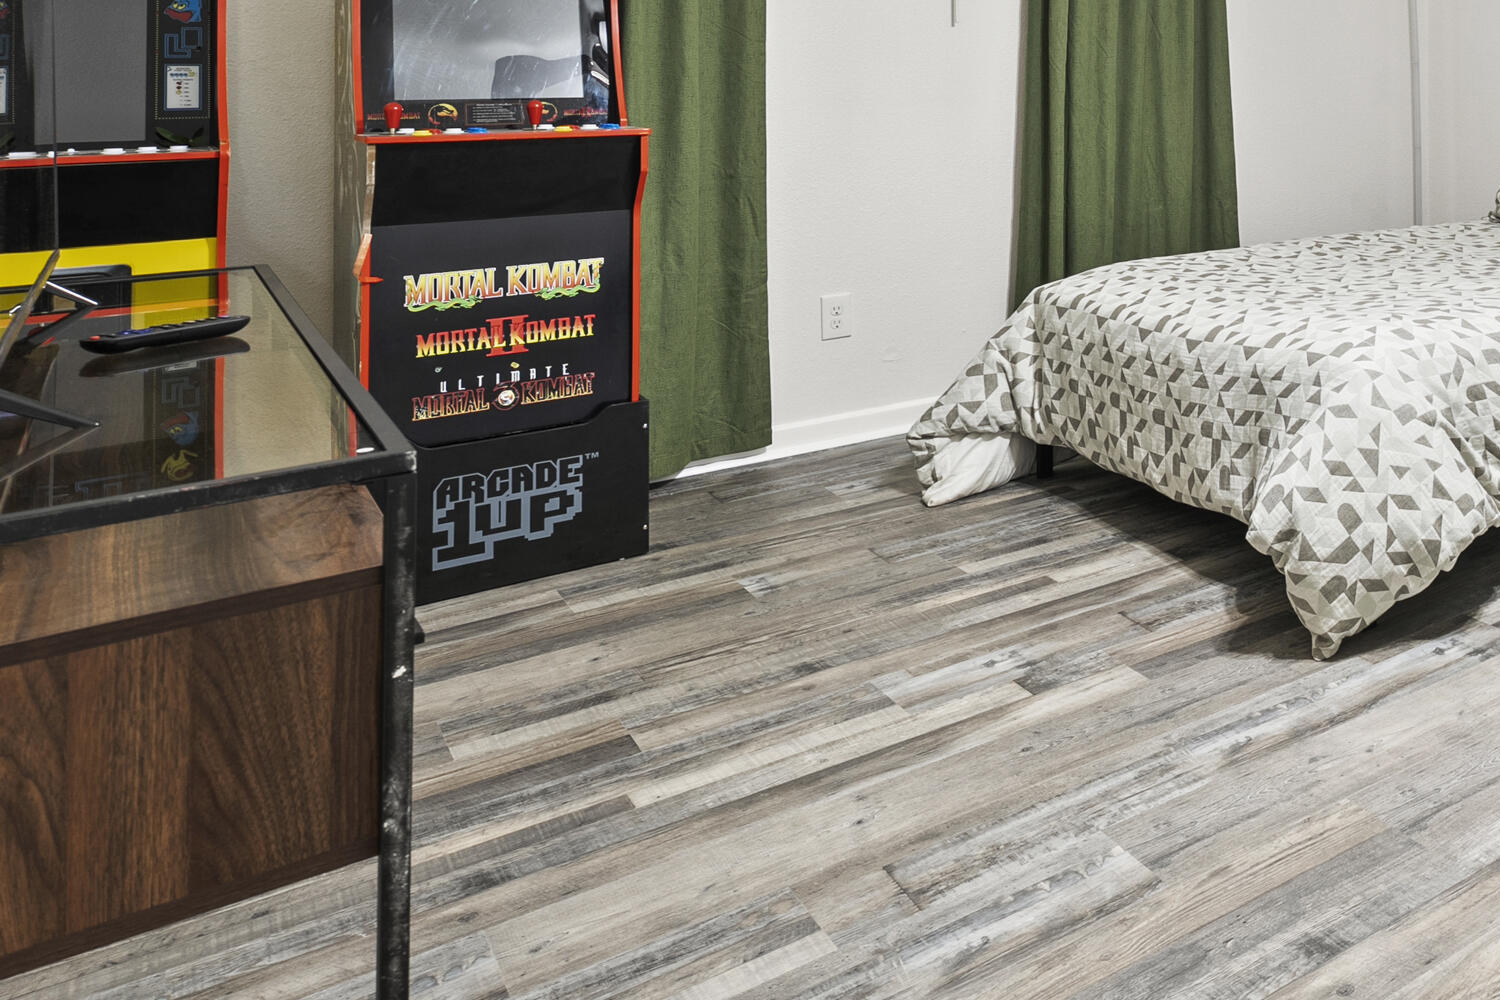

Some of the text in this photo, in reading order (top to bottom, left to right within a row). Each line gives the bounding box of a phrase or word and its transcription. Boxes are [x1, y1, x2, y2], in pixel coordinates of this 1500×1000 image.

[403, 257, 604, 307] MORTAL KOMBAT
[416, 325, 506, 358] MORTAL
[509, 314, 596, 346] KOMBAT
[411, 387, 490, 421] MORTAL
[521, 372, 596, 405] KOMBAT
[440, 363, 570, 392] ULTIMATE
[433, 454, 583, 510] ARCADE
[432, 487, 583, 572] 1UP
